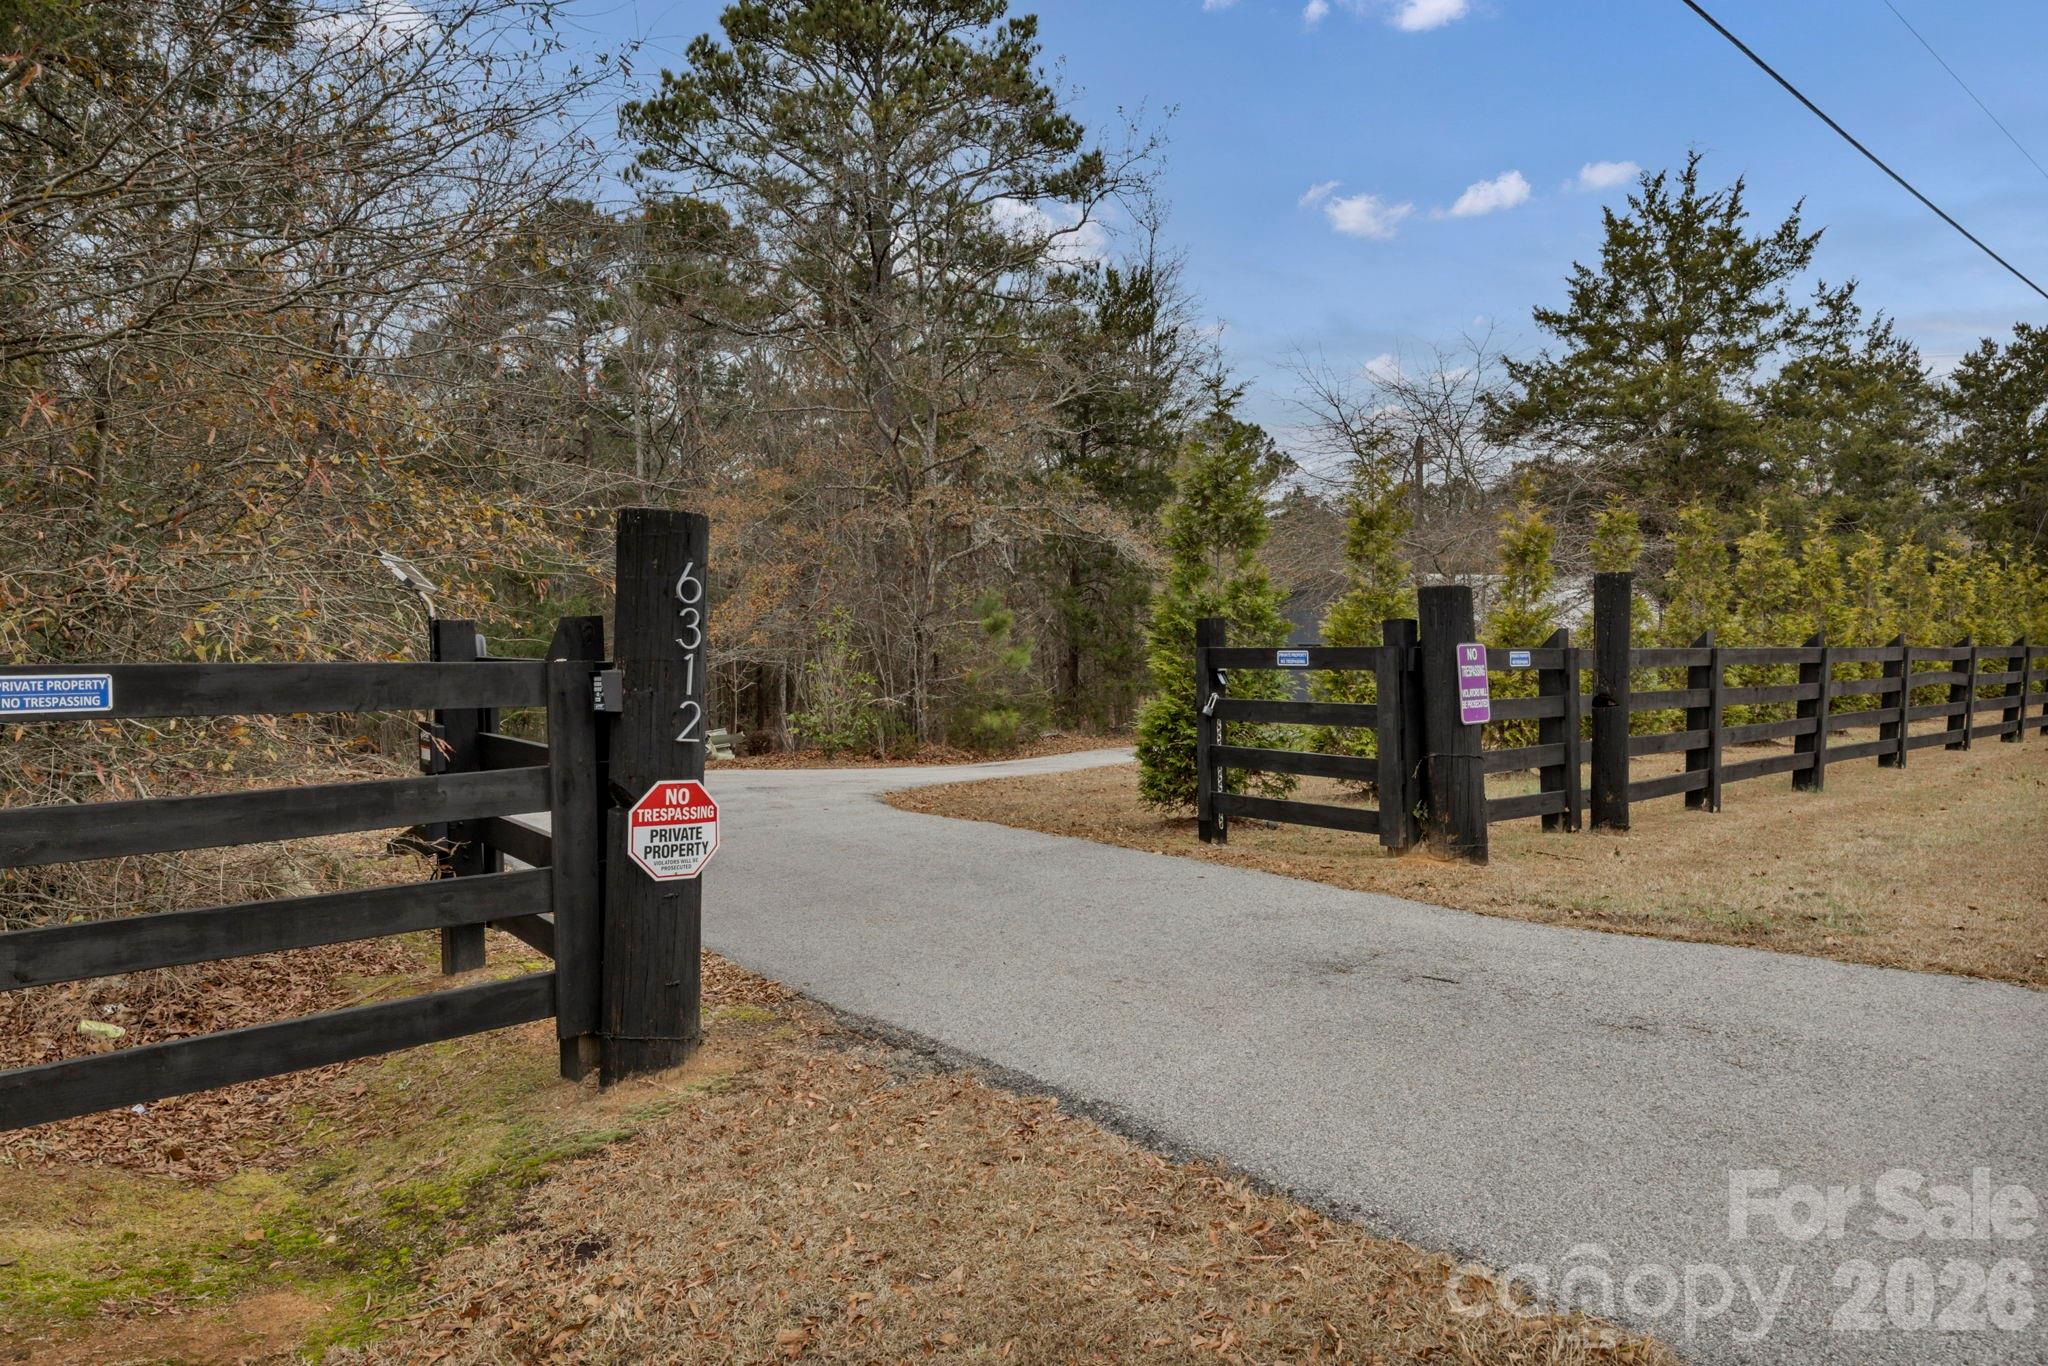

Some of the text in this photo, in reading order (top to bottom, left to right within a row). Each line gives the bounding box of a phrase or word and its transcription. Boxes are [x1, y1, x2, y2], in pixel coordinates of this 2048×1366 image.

[675, 561, 702, 742] 6312
[1467, 648, 1477, 660] NO
[46, 679, 106, 691] PROPERTY
[1, 695, 100, 709] NO TRESPASSING
[665, 788, 690, 806] NO
[637, 805, 715, 823] TRESPASSING
[650, 826, 703, 844] PRIVATE
[643, 841, 709, 860] PROPERTY
